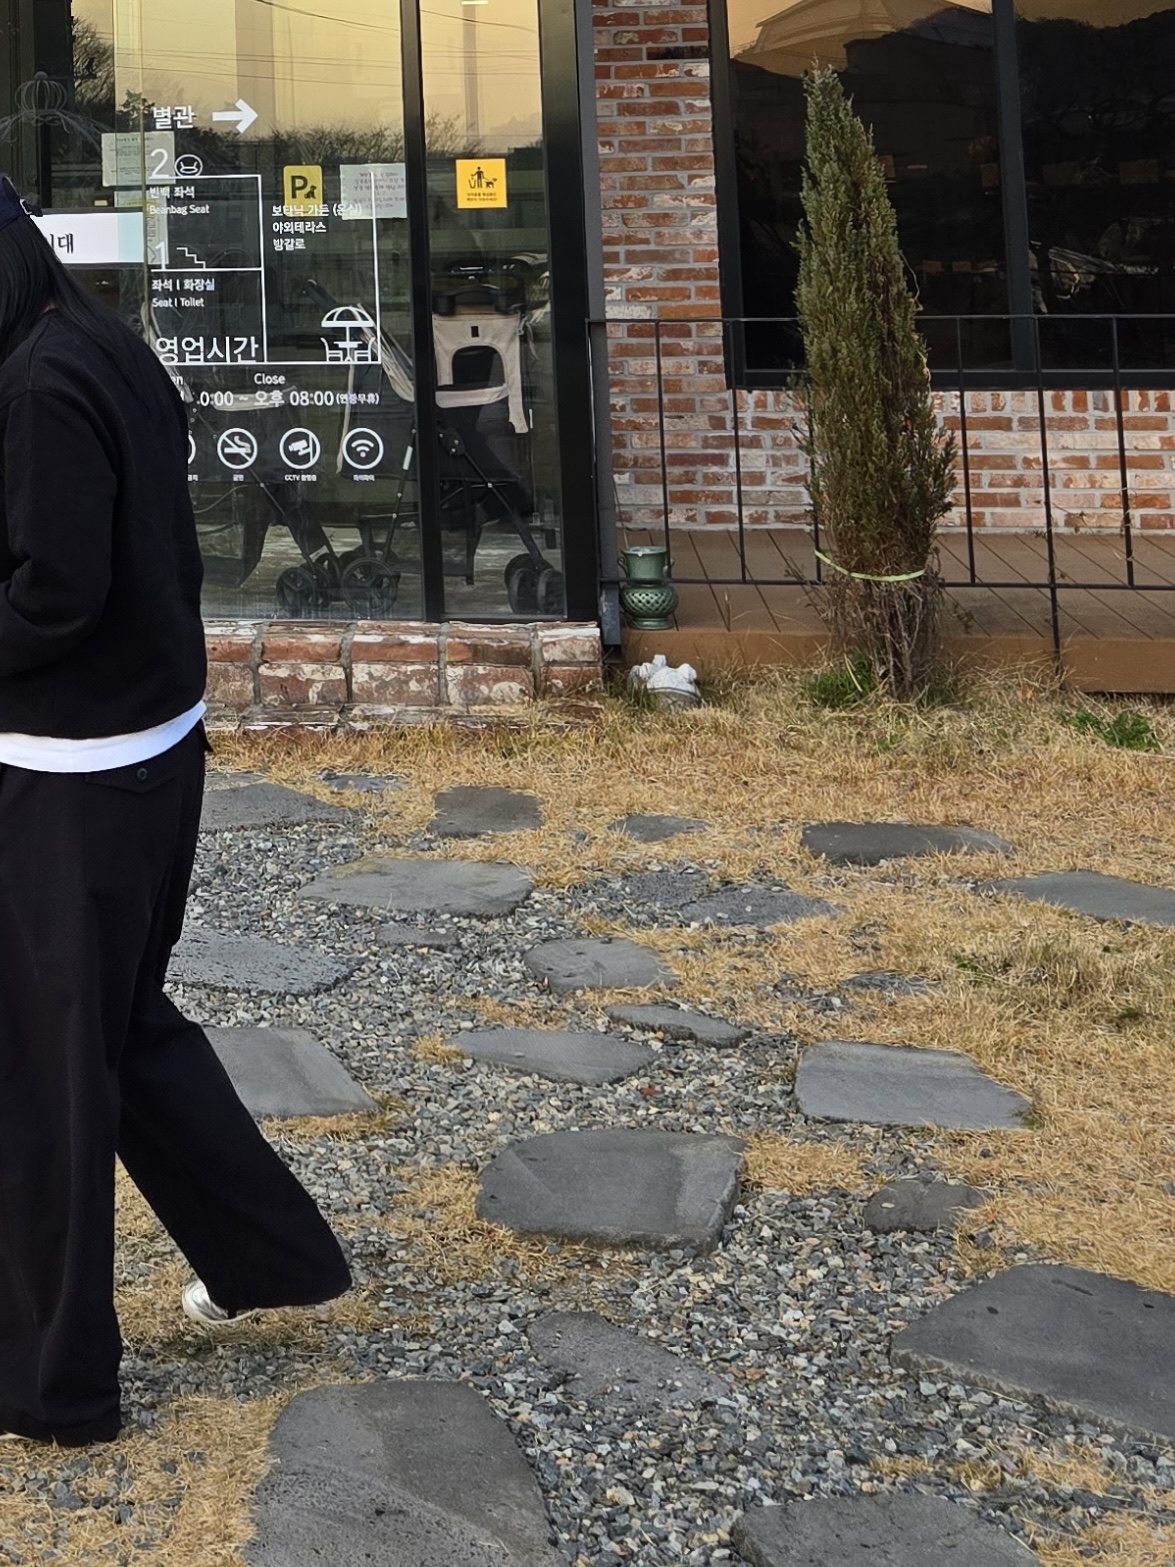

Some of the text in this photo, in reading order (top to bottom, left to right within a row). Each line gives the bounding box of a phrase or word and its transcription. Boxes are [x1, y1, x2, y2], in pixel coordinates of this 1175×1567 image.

[152, 105, 196, 129] 별관
[150, 148, 170, 177] 2
[174, 186, 195, 198] 좌석
[291, 175, 308, 199] P
[149, 204, 210, 215] Beanbag Seat
[272, 221, 327, 234] 야외테라스
[273, 238, 306, 251] 방갈로
[152, 278, 215, 291] 좌석 화장실
[152, 297, 204, 308] Seat Toilet
[156, 336, 259, 364] 영업시간
[254, 373, 286, 384] Close
[254, 390, 285, 407] 오후
[290, 391, 334, 406] 08:00
